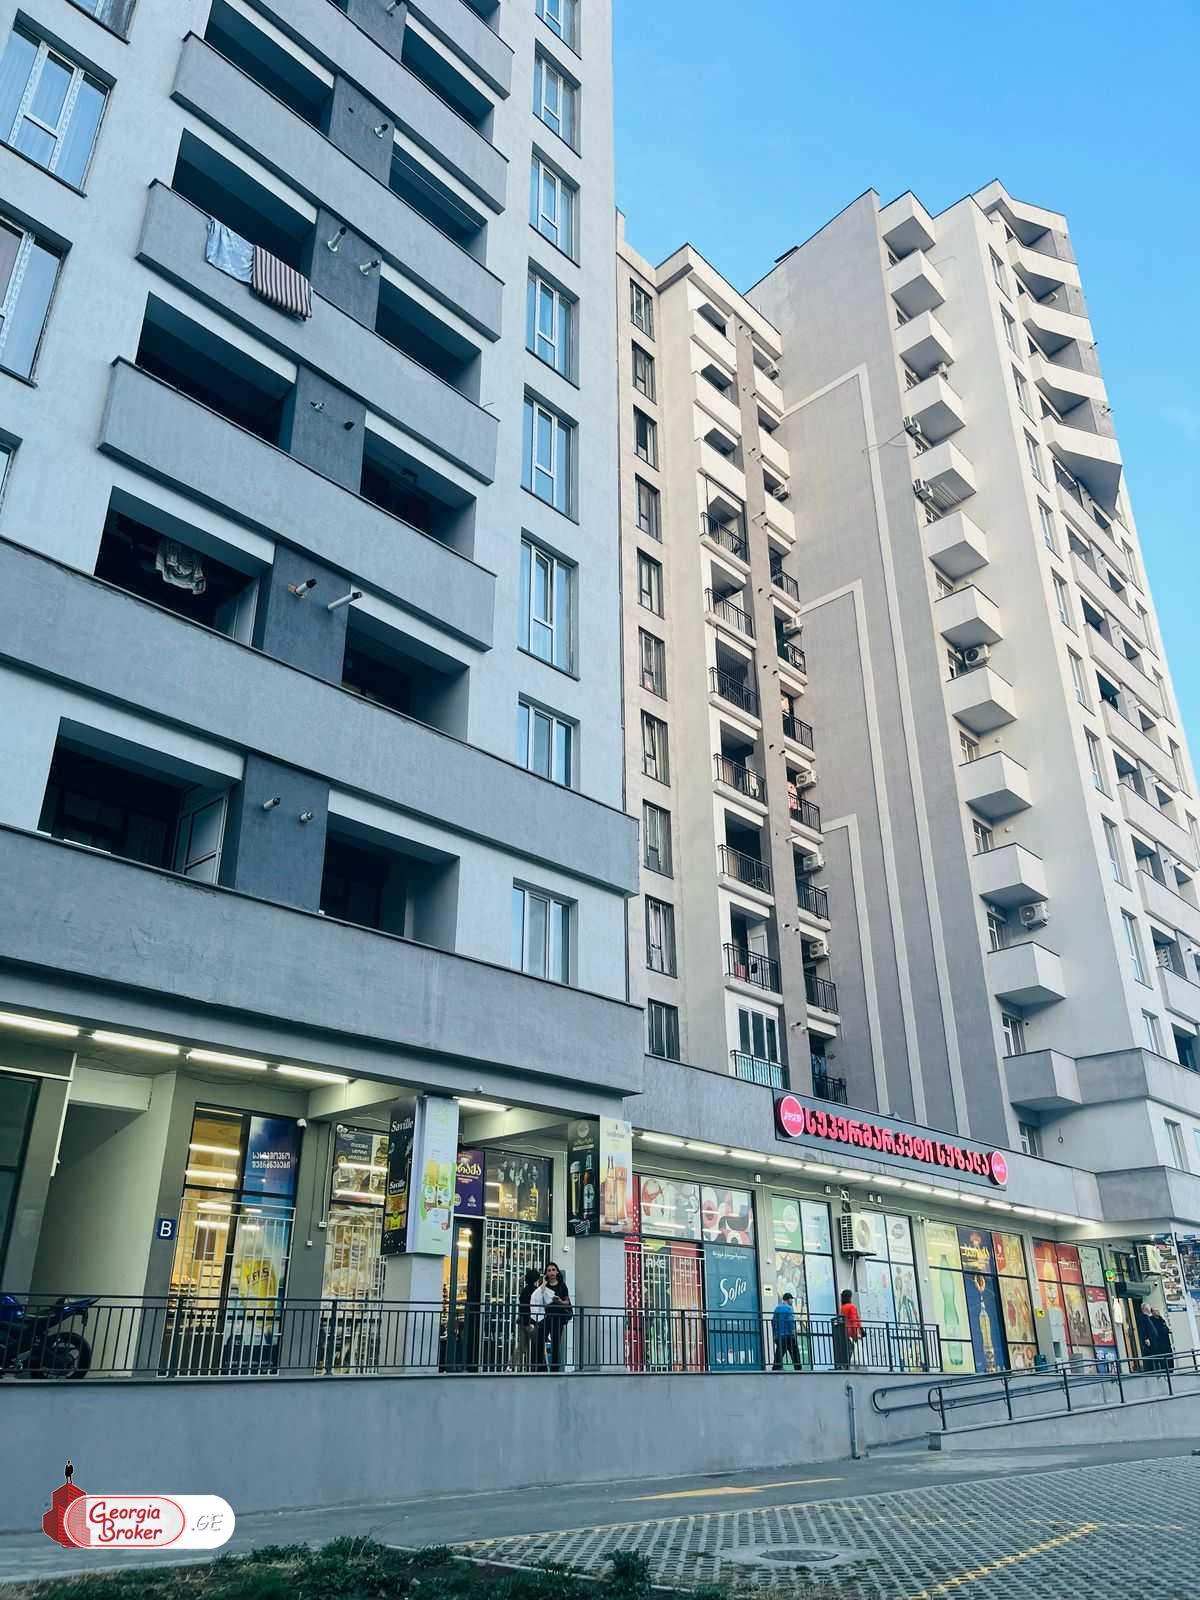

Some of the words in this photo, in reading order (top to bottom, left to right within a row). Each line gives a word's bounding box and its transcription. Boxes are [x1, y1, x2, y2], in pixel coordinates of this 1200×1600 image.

[391, 1117, 415, 1133] Saville
[805, 1107, 934, 1163] სუპერმარკეტი
[160, 1220, 172, 1238] B
[719, 1277, 748, 1307] Sofia
